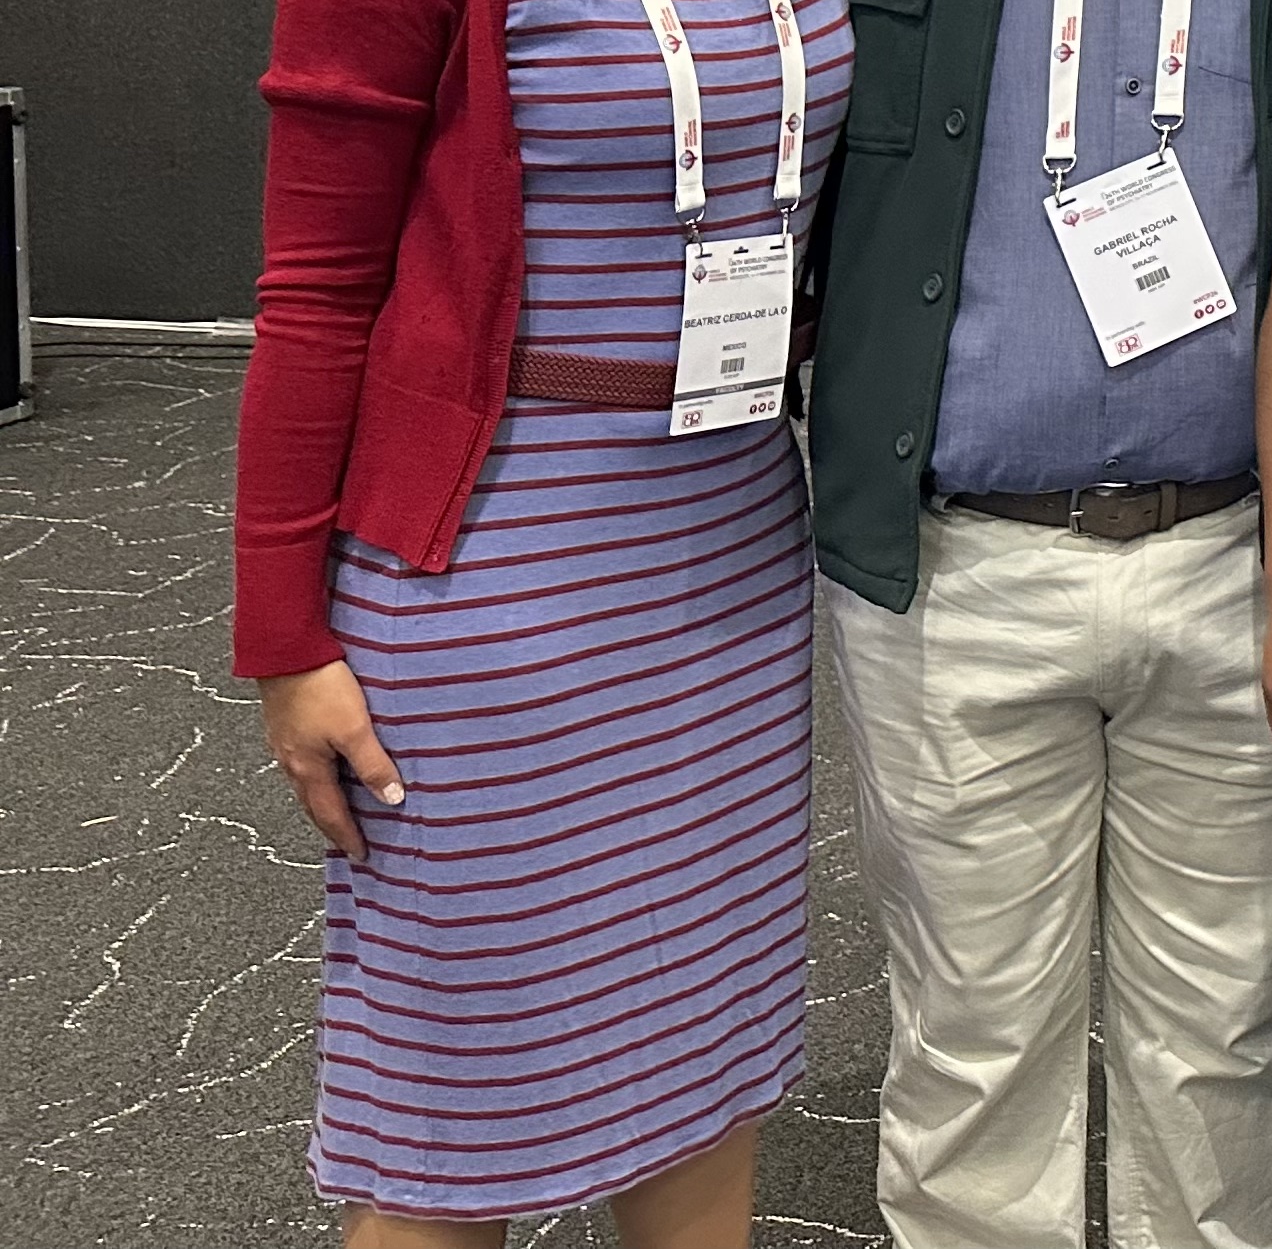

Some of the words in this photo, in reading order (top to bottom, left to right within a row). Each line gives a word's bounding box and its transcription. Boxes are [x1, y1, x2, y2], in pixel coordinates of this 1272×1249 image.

[1093, 231, 1140, 256] GABRIEL
[1140, 215, 1178, 236] ROCHA
[1132, 255, 1160, 270] BRAZIL
[684, 315, 721, 329] BEATRIZ
[722, 308, 767, 323] CERDA-DE
[767, 307, 780, 317] LA
